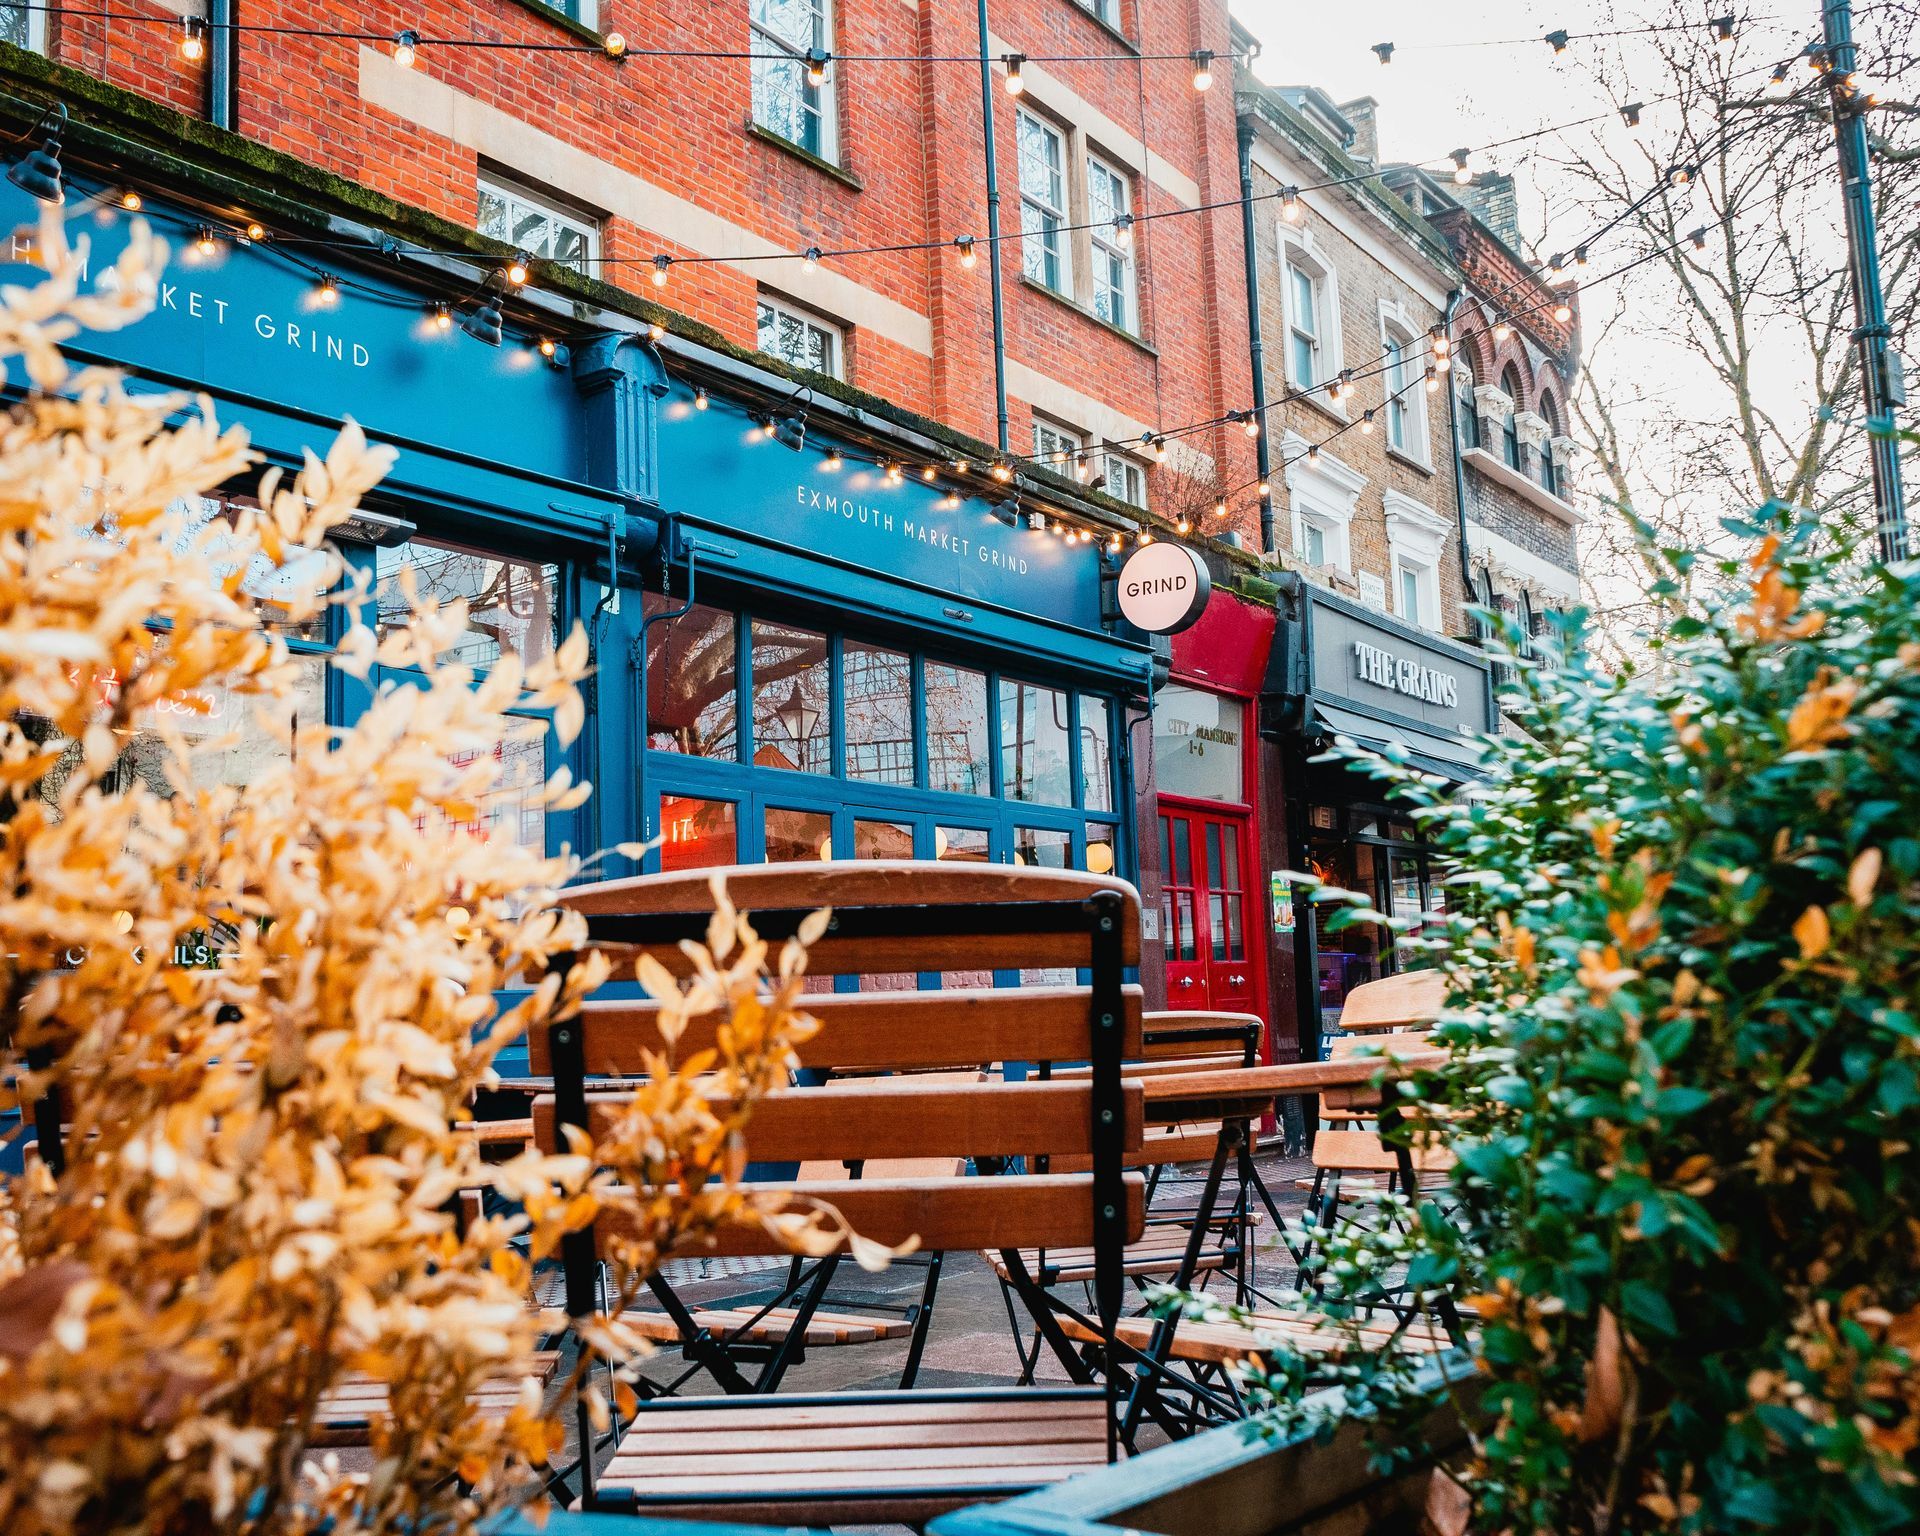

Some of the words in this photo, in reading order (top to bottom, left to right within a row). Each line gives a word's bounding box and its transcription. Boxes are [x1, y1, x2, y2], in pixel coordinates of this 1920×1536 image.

[255, 314, 370, 367] GRIND
[797, 485, 893, 532] EXMOUTH
[904, 520, 969, 556] MARKET
[978, 546, 1028, 575] GRIND
[1126, 575, 1187, 598] GRIND
[1354, 640, 1396, 690] THE
[1395, 658, 1458, 709] GRAINS
[1168, 719, 1190, 736] CITY
[1196, 724, 1238, 746] MANSIONS
[1189, 740, 1204, 756] 1-6
